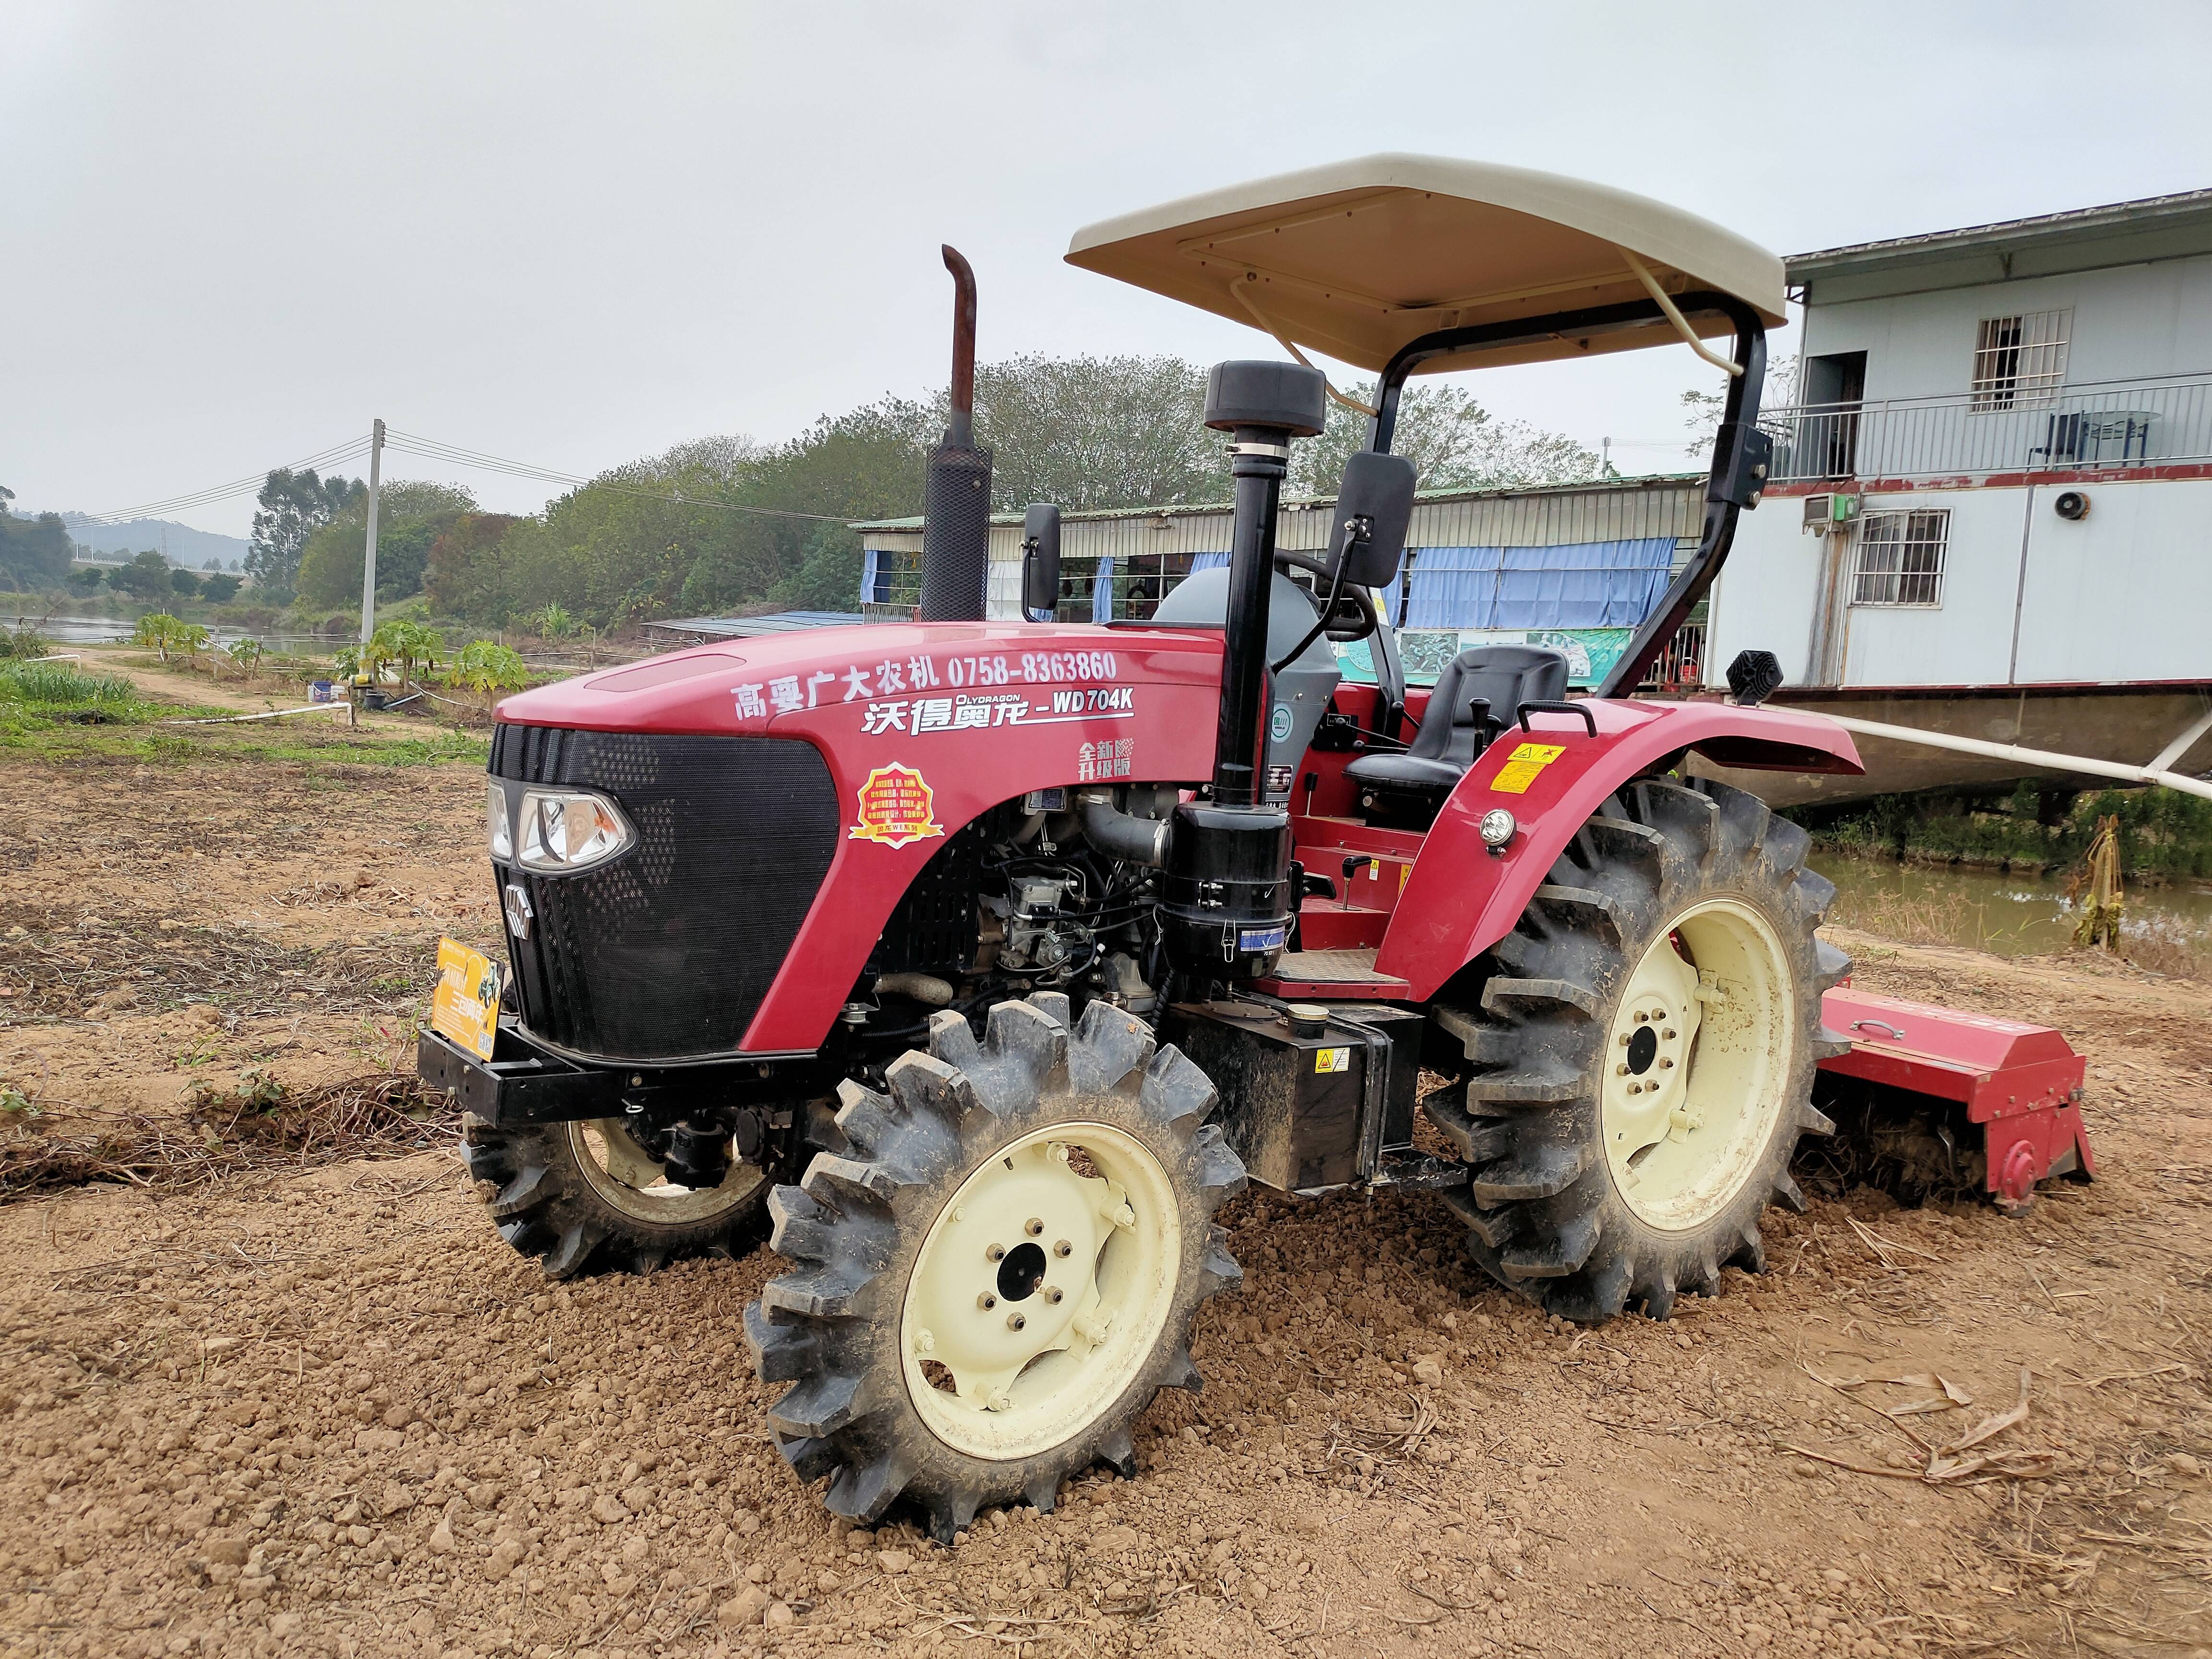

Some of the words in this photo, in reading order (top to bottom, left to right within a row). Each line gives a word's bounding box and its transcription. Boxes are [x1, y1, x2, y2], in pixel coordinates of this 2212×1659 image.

[730, 655, 939, 721] 高要广大农机
[948, 651, 1117, 687] 0758-8363860
[955, 693, 1021, 705] OLYDRAGON
[1078, 757, 1130, 781] 升级版
